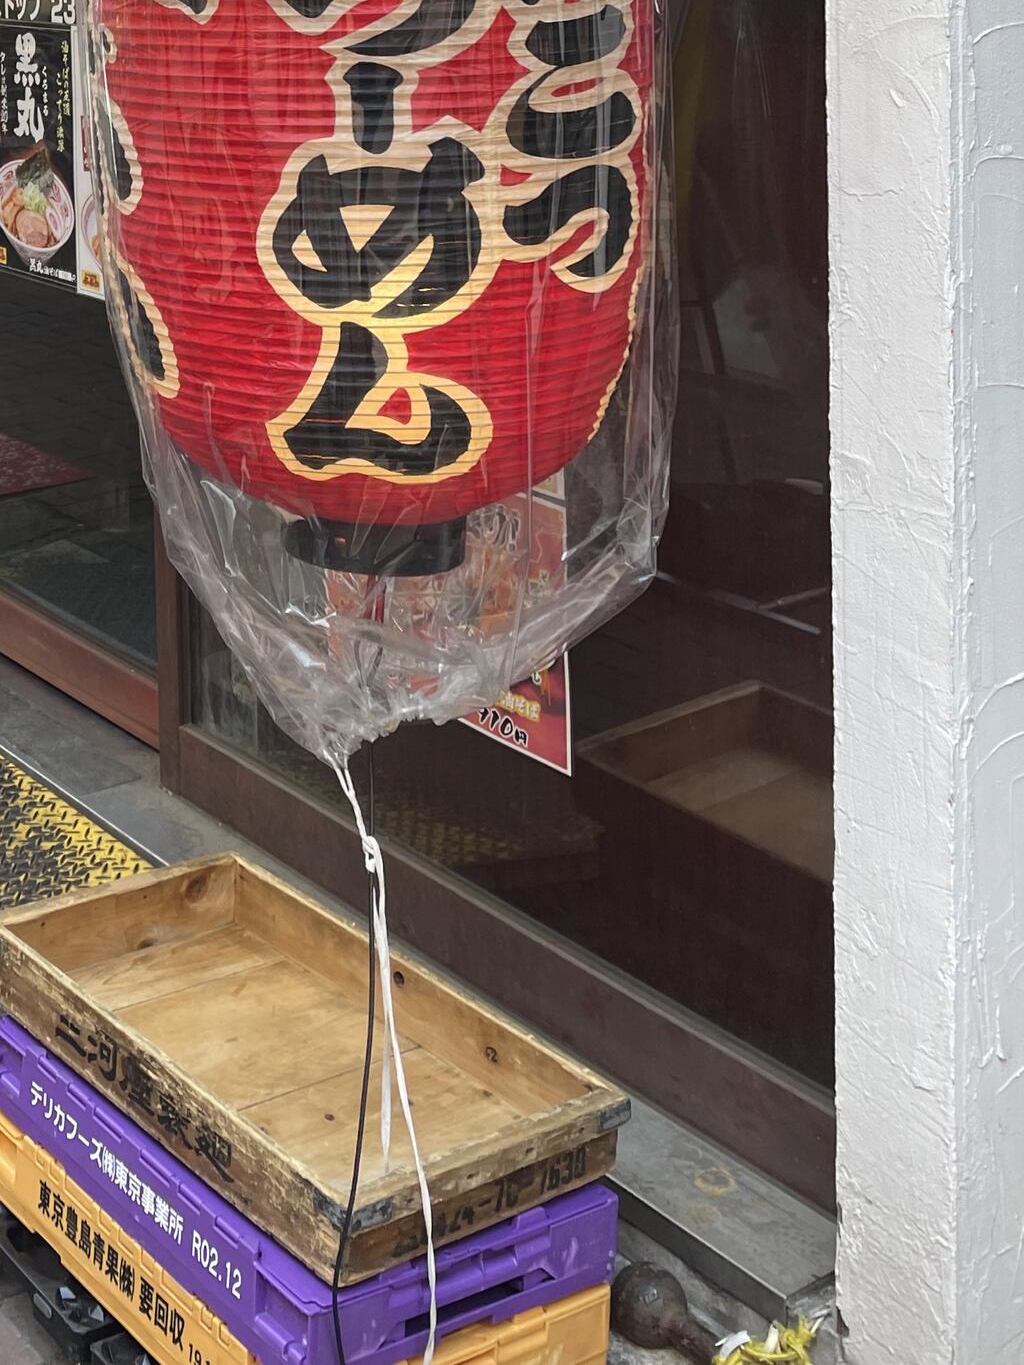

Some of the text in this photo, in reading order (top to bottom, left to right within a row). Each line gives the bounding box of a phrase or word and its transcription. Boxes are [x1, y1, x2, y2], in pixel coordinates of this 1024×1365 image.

[13, 32, 45, 143] 黒丸
[191, 1230, 243, 1300] R02.12
[139, 1276, 186, 1352] 要回収
